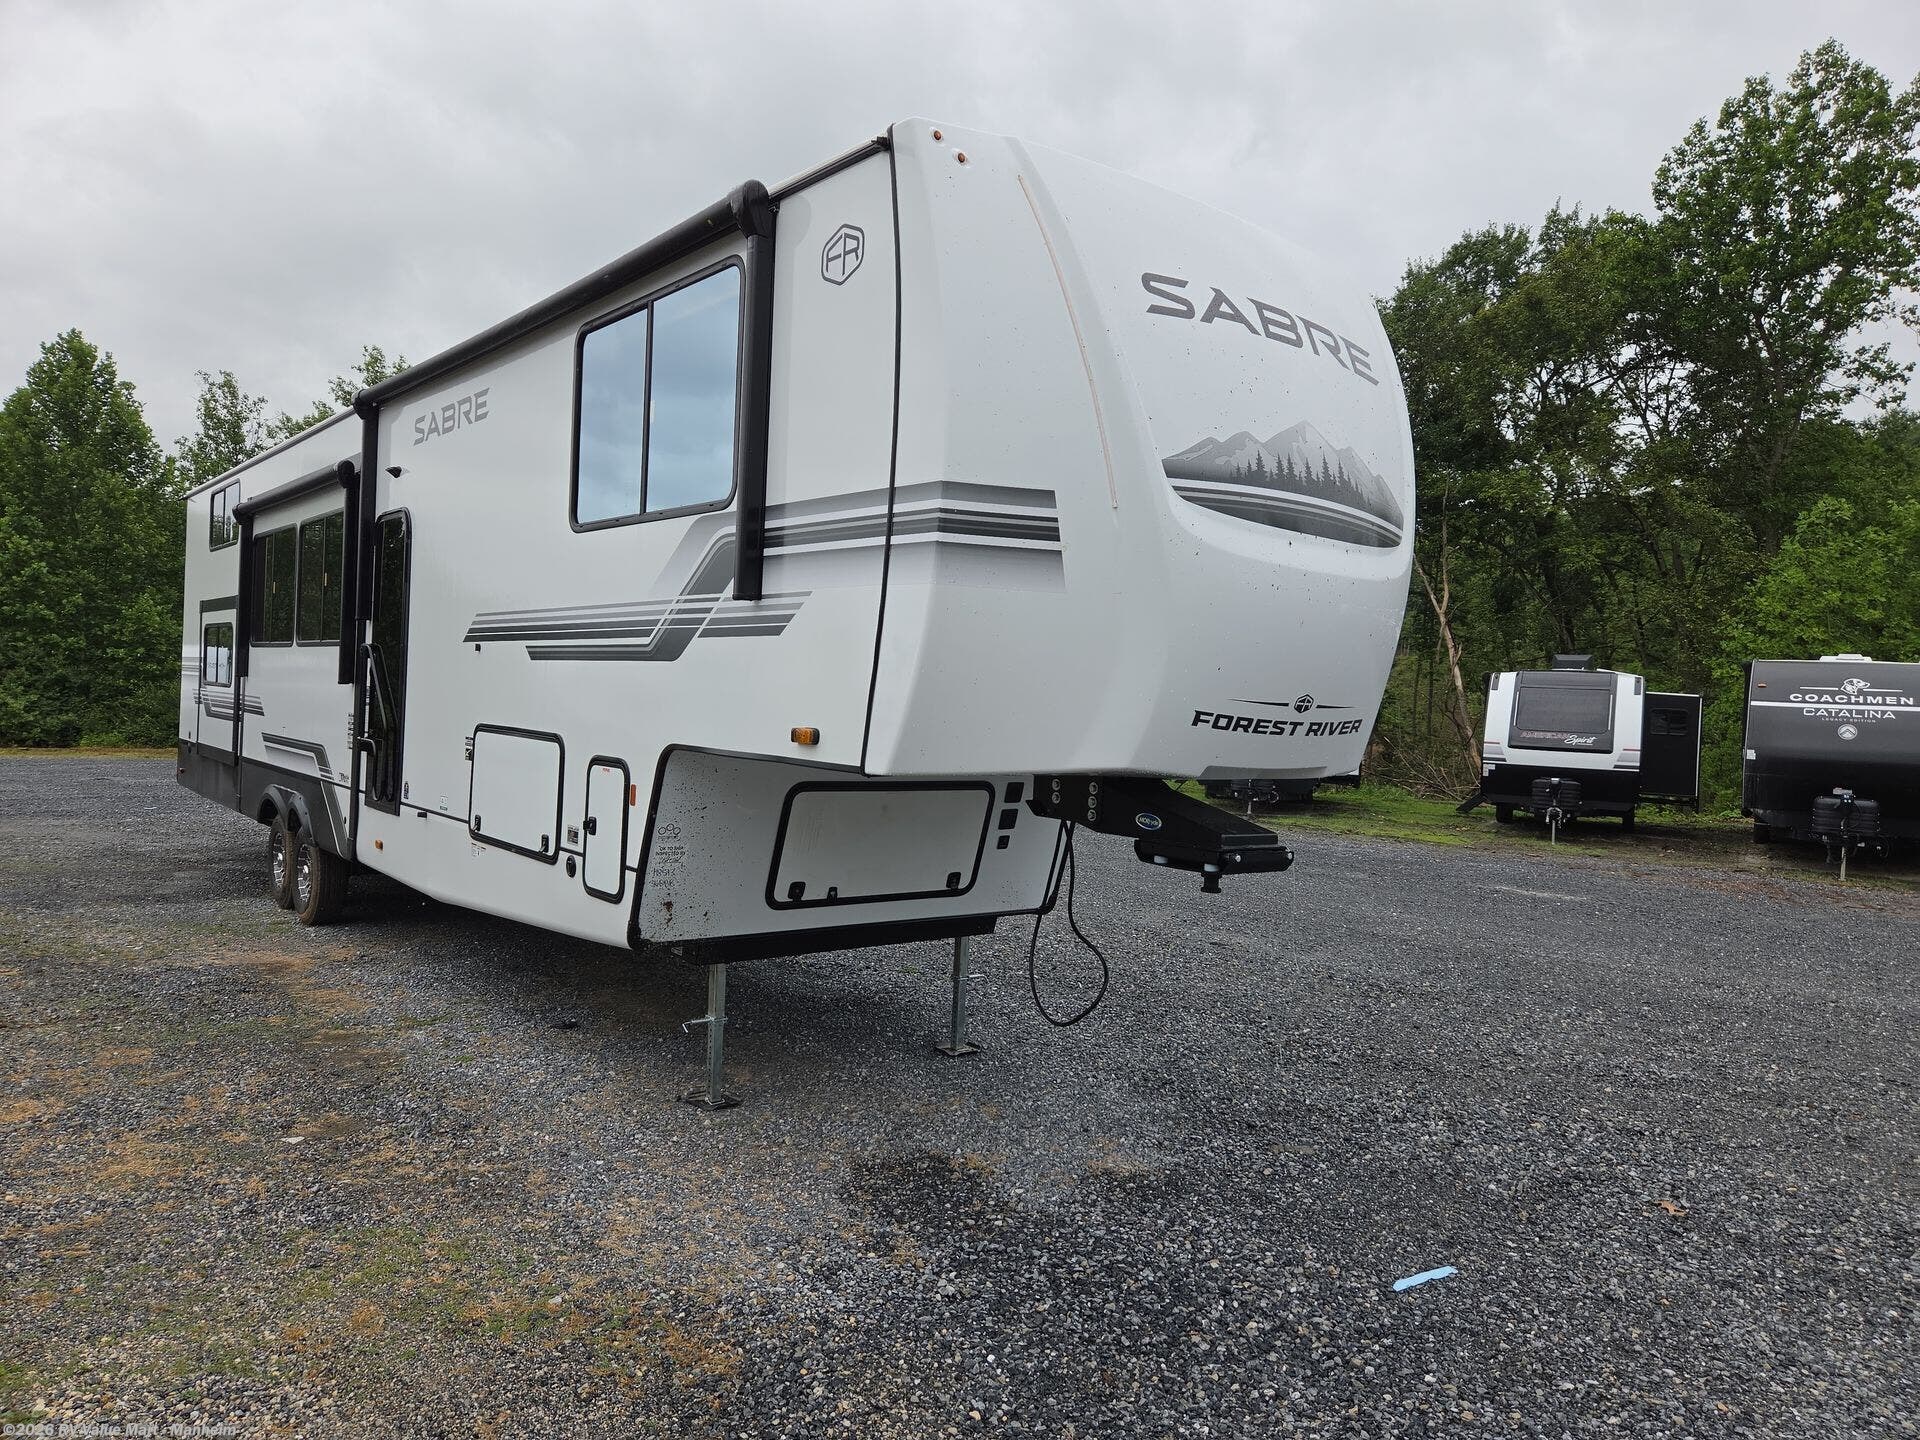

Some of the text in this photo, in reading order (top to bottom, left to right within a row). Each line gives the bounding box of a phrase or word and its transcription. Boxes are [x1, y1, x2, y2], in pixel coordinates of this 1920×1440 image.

[1141, 272, 1380, 386] SABRE
[413, 387, 490, 446] SABRE
[1789, 693, 1914, 705] COACHMEN
[1191, 709, 1363, 737] FOREST RIVER
[1803, 707, 1896, 720] CATALINA
[1564, 734, 1597, 746] Spirit
